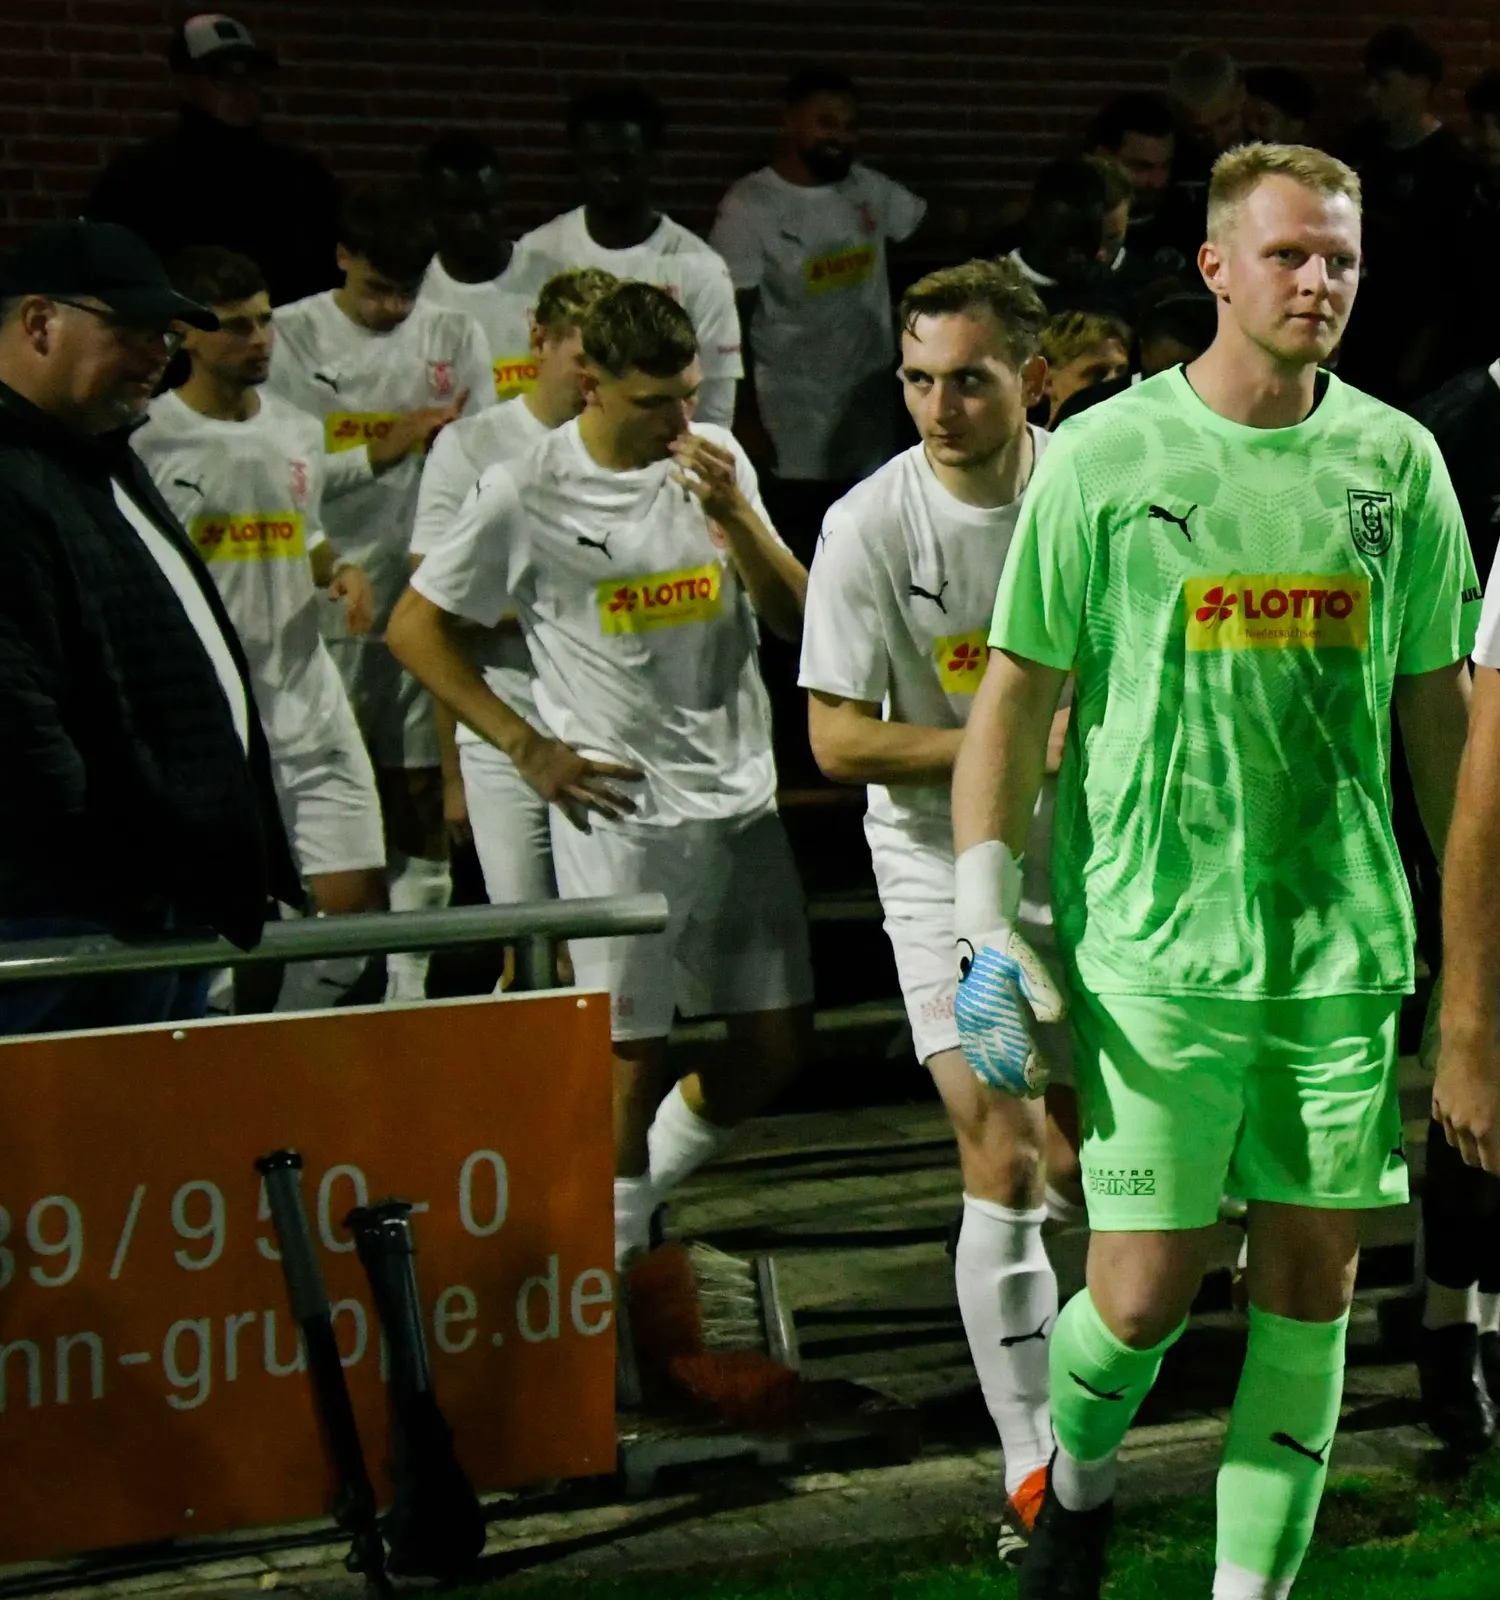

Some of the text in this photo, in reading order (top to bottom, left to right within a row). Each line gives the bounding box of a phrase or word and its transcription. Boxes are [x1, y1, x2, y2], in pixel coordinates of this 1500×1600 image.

[494, 364, 539, 383] OTTO
[229, 522, 294, 542] LOTTO
[642, 577, 712, 608] LOTTO
[1244, 589, 1353, 619] LOTTO
